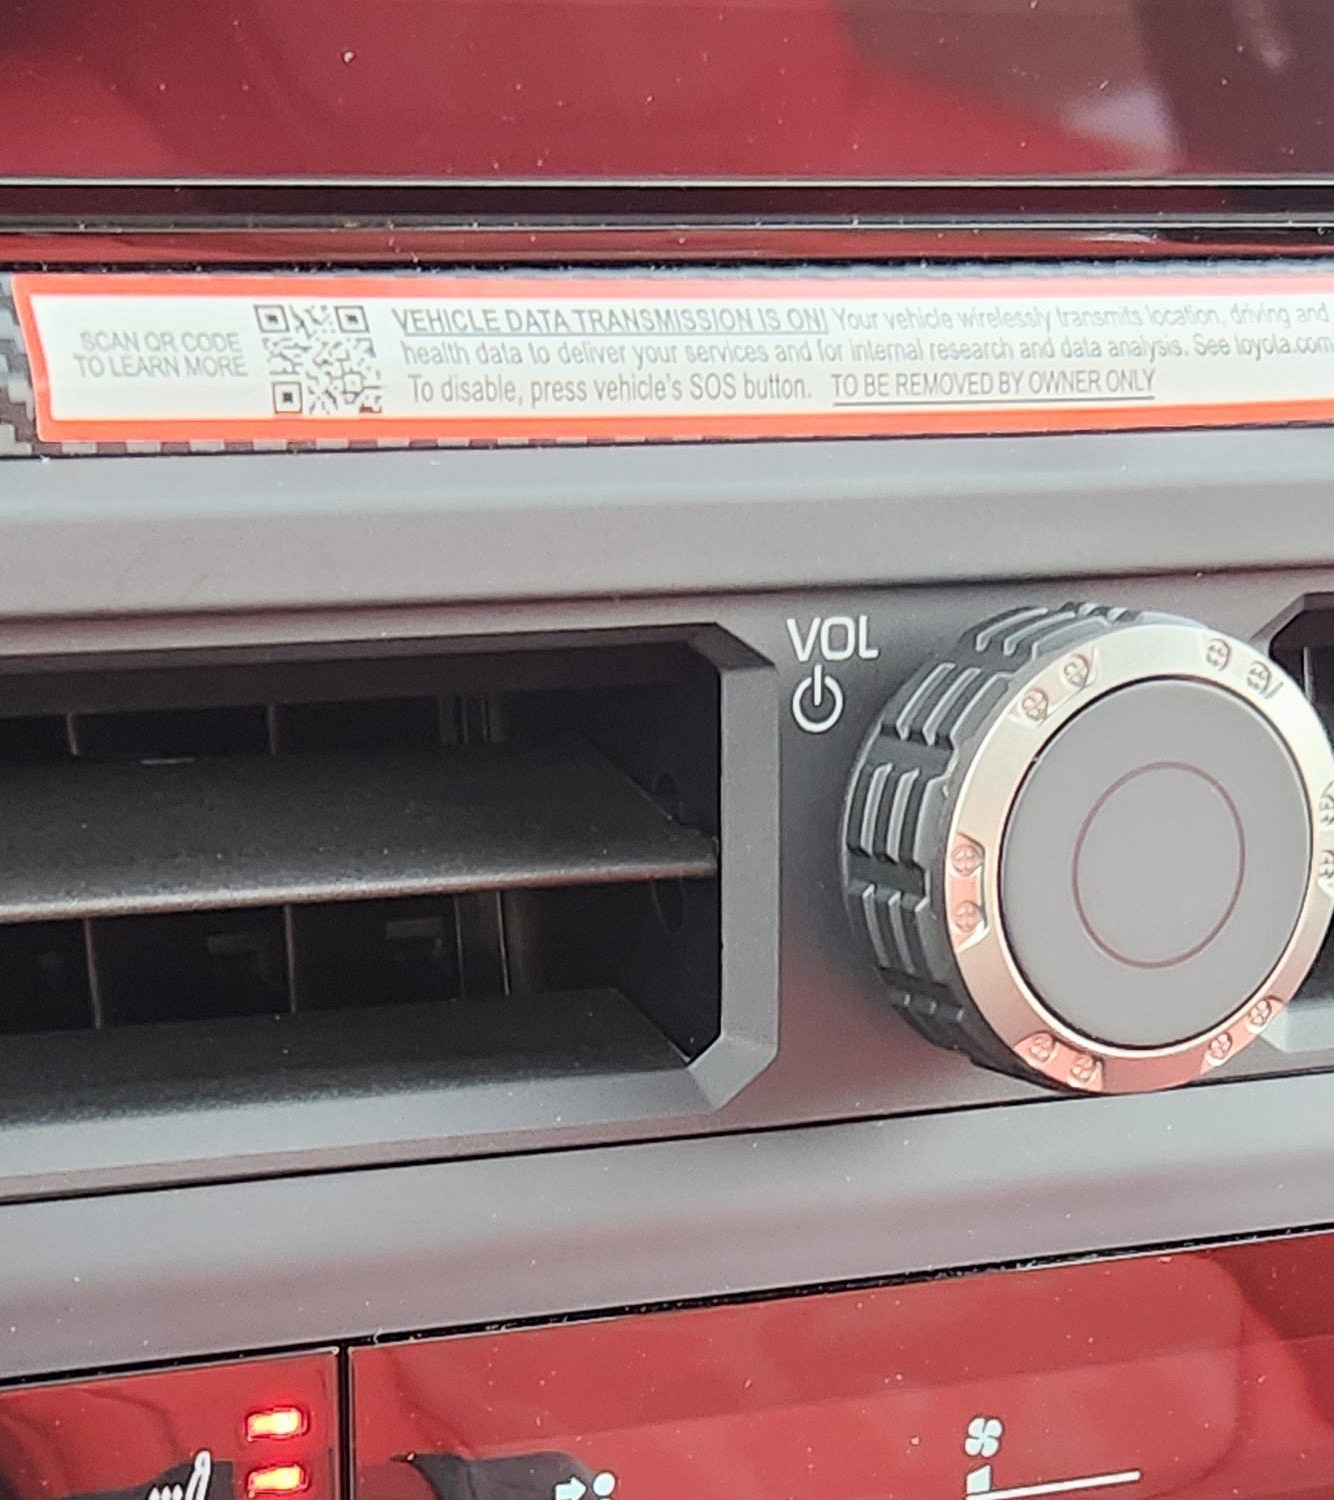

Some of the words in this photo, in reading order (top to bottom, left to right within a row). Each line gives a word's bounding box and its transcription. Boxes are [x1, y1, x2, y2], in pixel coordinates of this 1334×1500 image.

[391, 309, 501, 333] VEHICLE
[508, 309, 568, 332] DATA
[569, 307, 754, 333] TRANSMISSION
[760, 307, 782, 332] IS
[833, 307, 878, 331] Your
[885, 306, 953, 330] vehicle
[957, 306, 1052, 333] wirelessly
[1056, 306, 1142, 328] transmits
[1146, 304, 1227, 327] location,
[1230, 302, 1291, 328] driving
[1295, 303, 1330, 323] and
[80, 330, 140, 352] SCAN
[145, 330, 178, 352] QR
[182, 331, 242, 352] CODE
[402, 339, 470, 366] health
[475, 339, 522, 365] data
[527, 340, 551, 364] to
[555, 339, 626, 364] deliver
[632, 343, 678, 370] your
[684, 340, 769, 363] services
[774, 339, 812, 362] and
[816, 338, 845, 362] for
[849, 337, 923, 362] internal
[929, 337, 1014, 360] research
[1019, 336, 1055, 359] and
[1060, 336, 1102, 359] data
[1107, 334, 1189, 363] analysis.
[1193, 332, 1231, 356] See
[73, 353, 105, 377] TO
[109, 355, 180, 377] LEARN
[184, 355, 248, 377] MORE
[408, 373, 437, 402] To
[442, 372, 522, 406] disable,
[530, 377, 590, 409] press
[593, 372, 682, 401] vehicle's
[689, 371, 738, 400] SOS
[743, 371, 811, 400] button.
[831, 372, 858, 397] TO
[864, 372, 891, 397] BE
[895, 370, 994, 396] REMOVED
[999, 370, 1024, 395] BY
[1028, 369, 1101, 394] OWNER
[1105, 368, 1156, 393] ONLY
[787, 615, 879, 663] VOL
